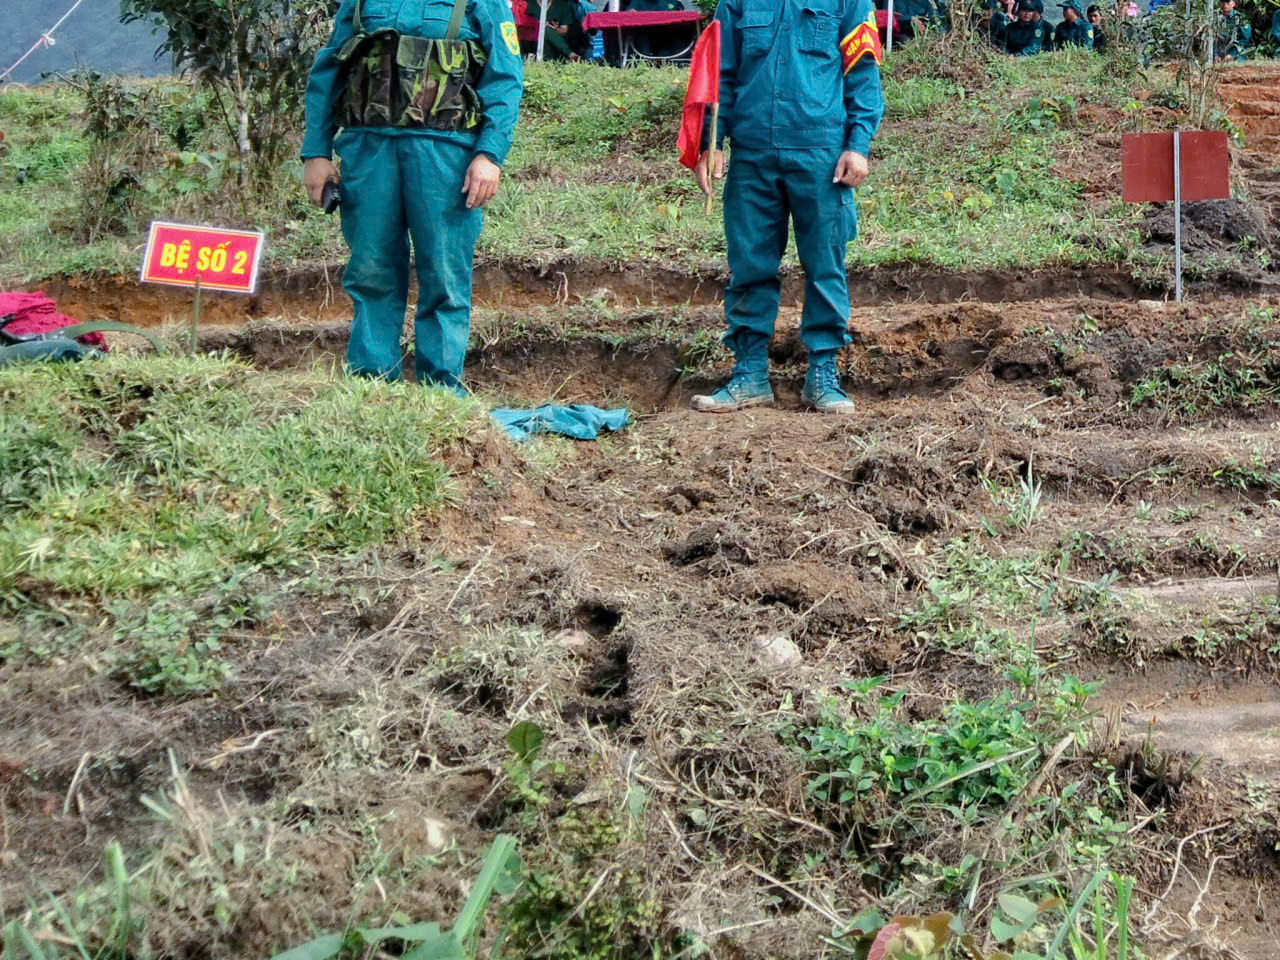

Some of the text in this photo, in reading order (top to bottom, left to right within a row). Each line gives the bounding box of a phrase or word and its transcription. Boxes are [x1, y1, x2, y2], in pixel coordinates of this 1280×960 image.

[160, 239, 248, 275] BỆ SỐ 2
